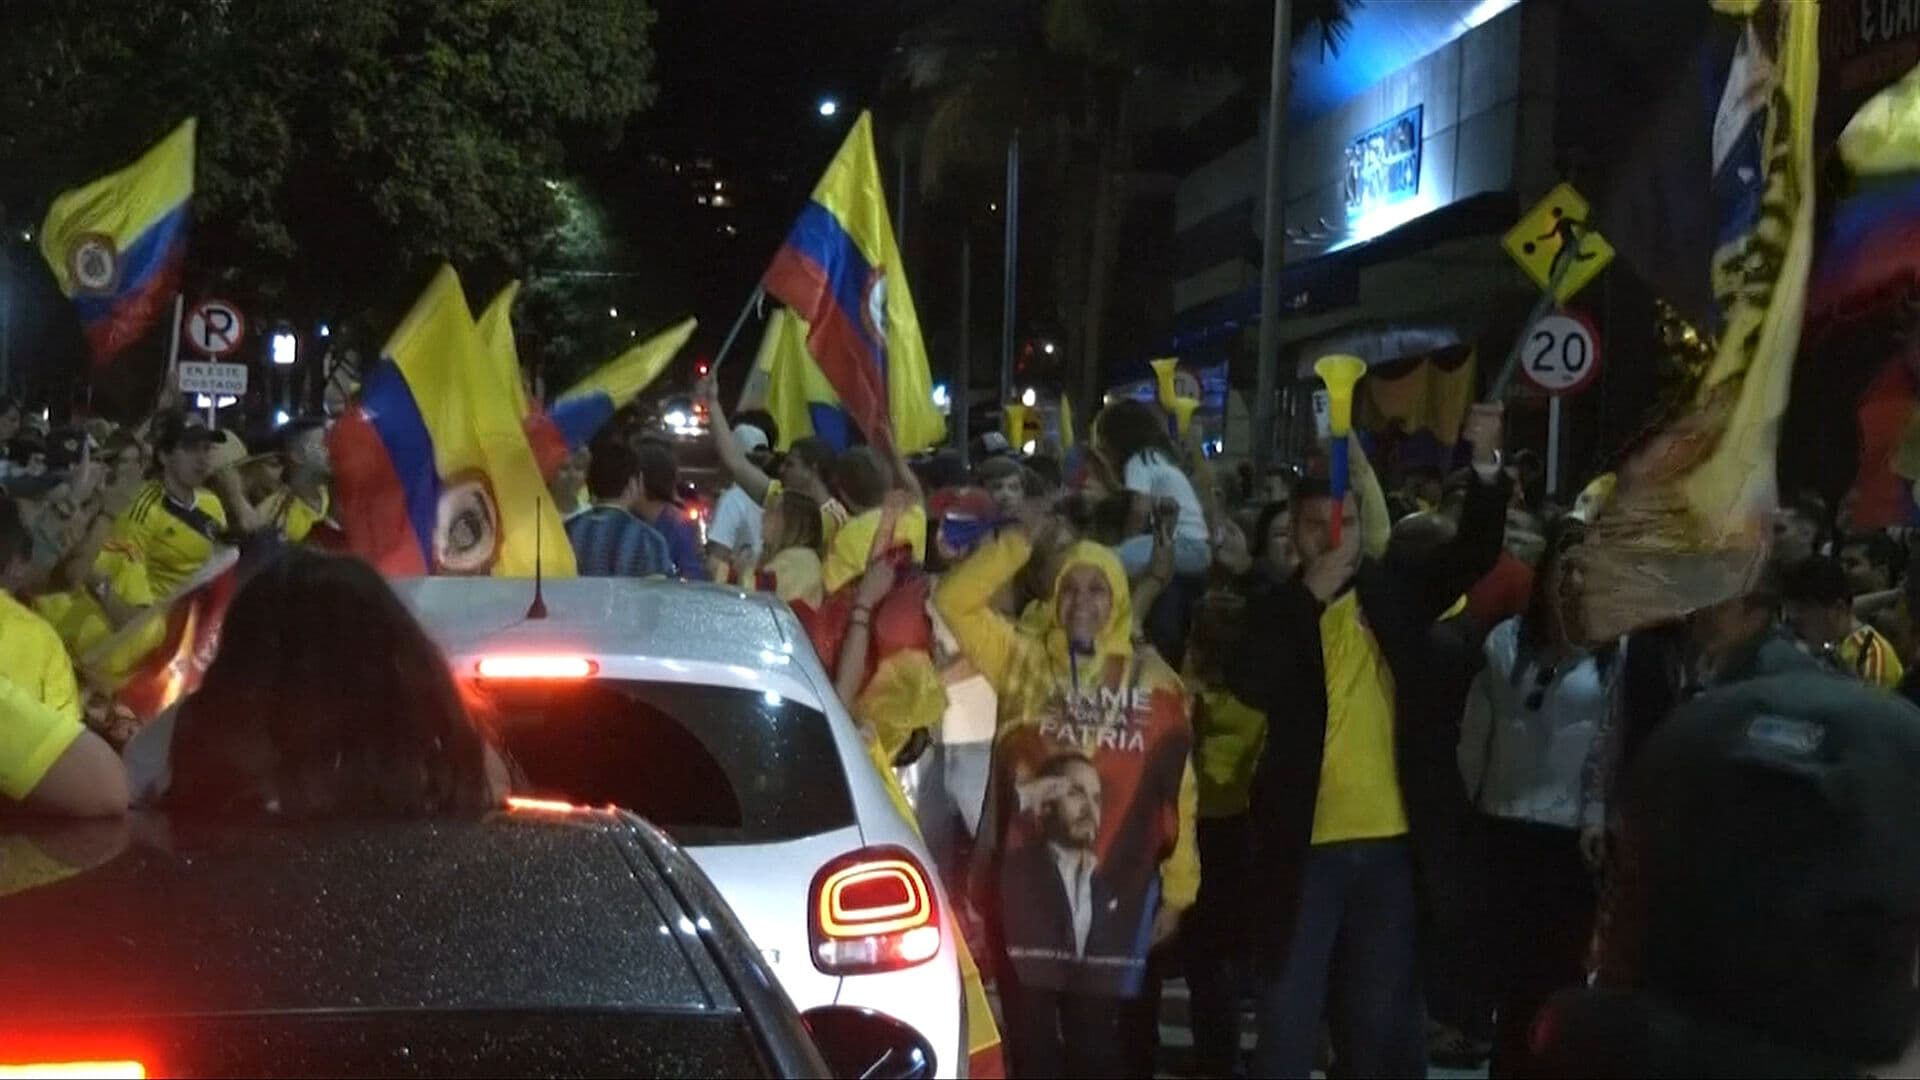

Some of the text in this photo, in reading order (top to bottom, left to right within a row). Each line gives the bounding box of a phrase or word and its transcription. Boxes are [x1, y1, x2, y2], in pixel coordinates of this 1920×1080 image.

[1532, 330, 1587, 373] 20
[186, 366, 241, 378] EN ESTE
[1039, 717, 1145, 753] PATRIA
